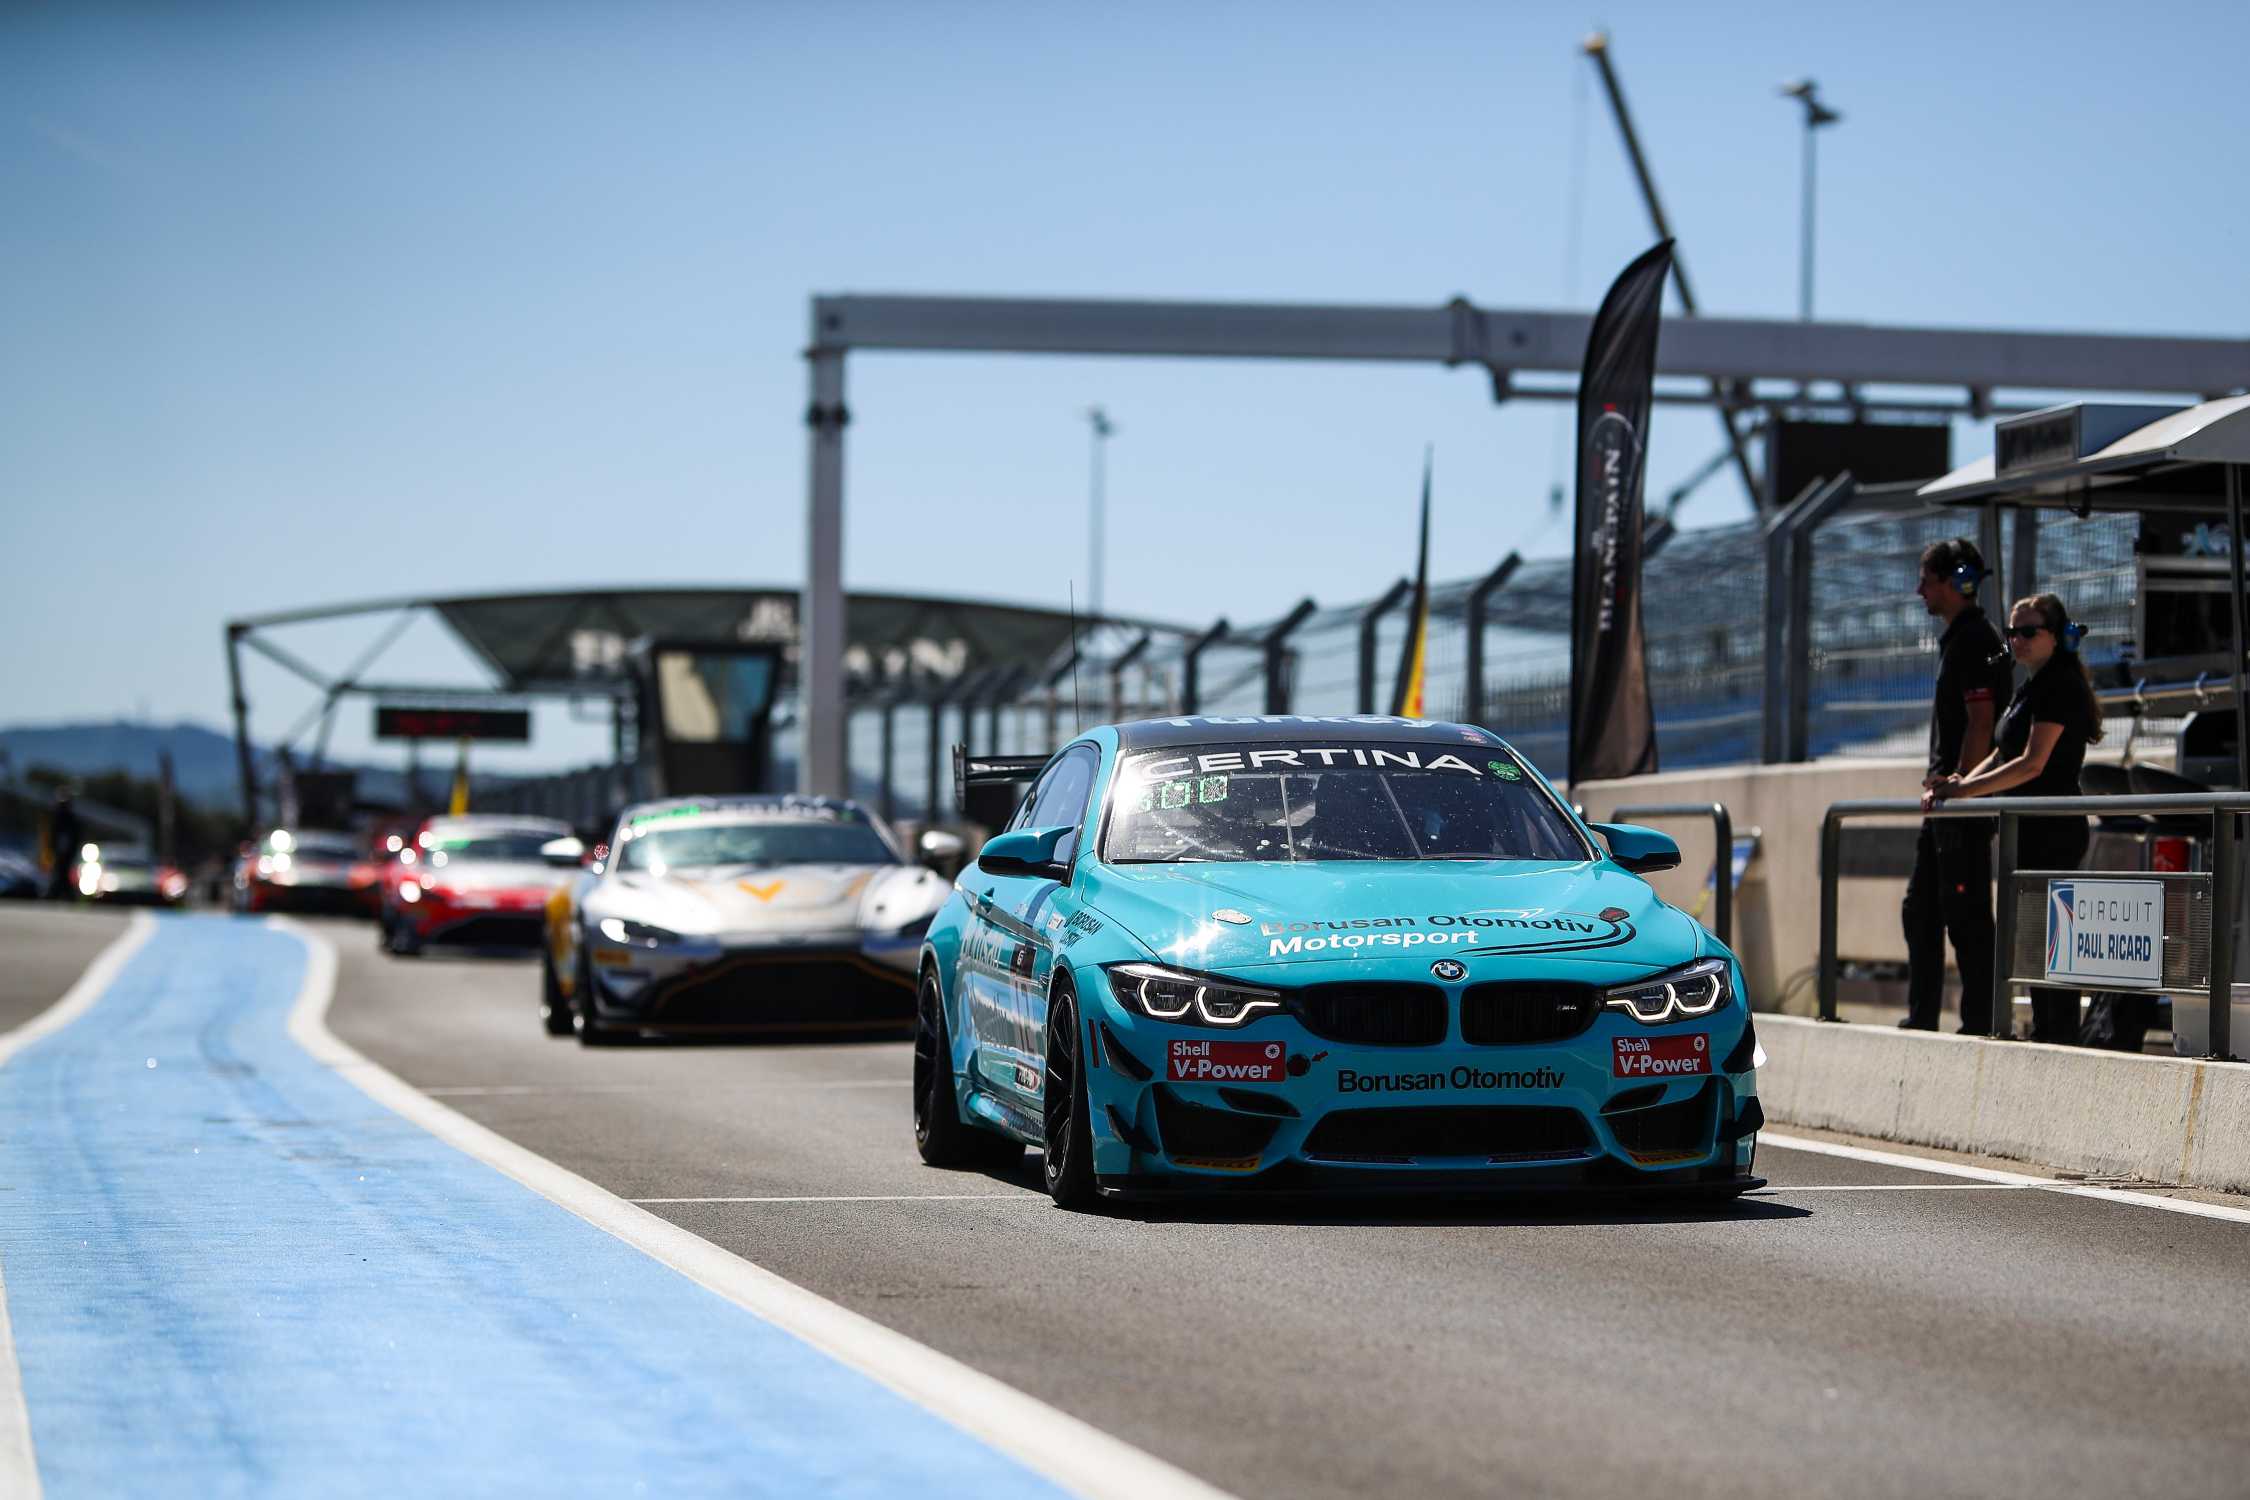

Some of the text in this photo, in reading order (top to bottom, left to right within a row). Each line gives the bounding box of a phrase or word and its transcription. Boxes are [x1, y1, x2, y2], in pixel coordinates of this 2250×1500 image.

[1141, 748, 1484, 779] CERTINA
[2078, 900, 2152, 922] CIRCUIT
[1260, 914, 1594, 937] Borusan Otomotiv
[1268, 930, 1479, 957] Motorsport
[2077, 933, 2151, 961] PAUL RICARD
[1173, 1041, 1210, 1056] Shell
[1616, 1038, 1650, 1052] Shell
[1174, 1059, 1272, 1079] V-Power
[1619, 1055, 1700, 1074] V-Power
[1337, 1066, 1565, 1093] Borusan Otomotiv
